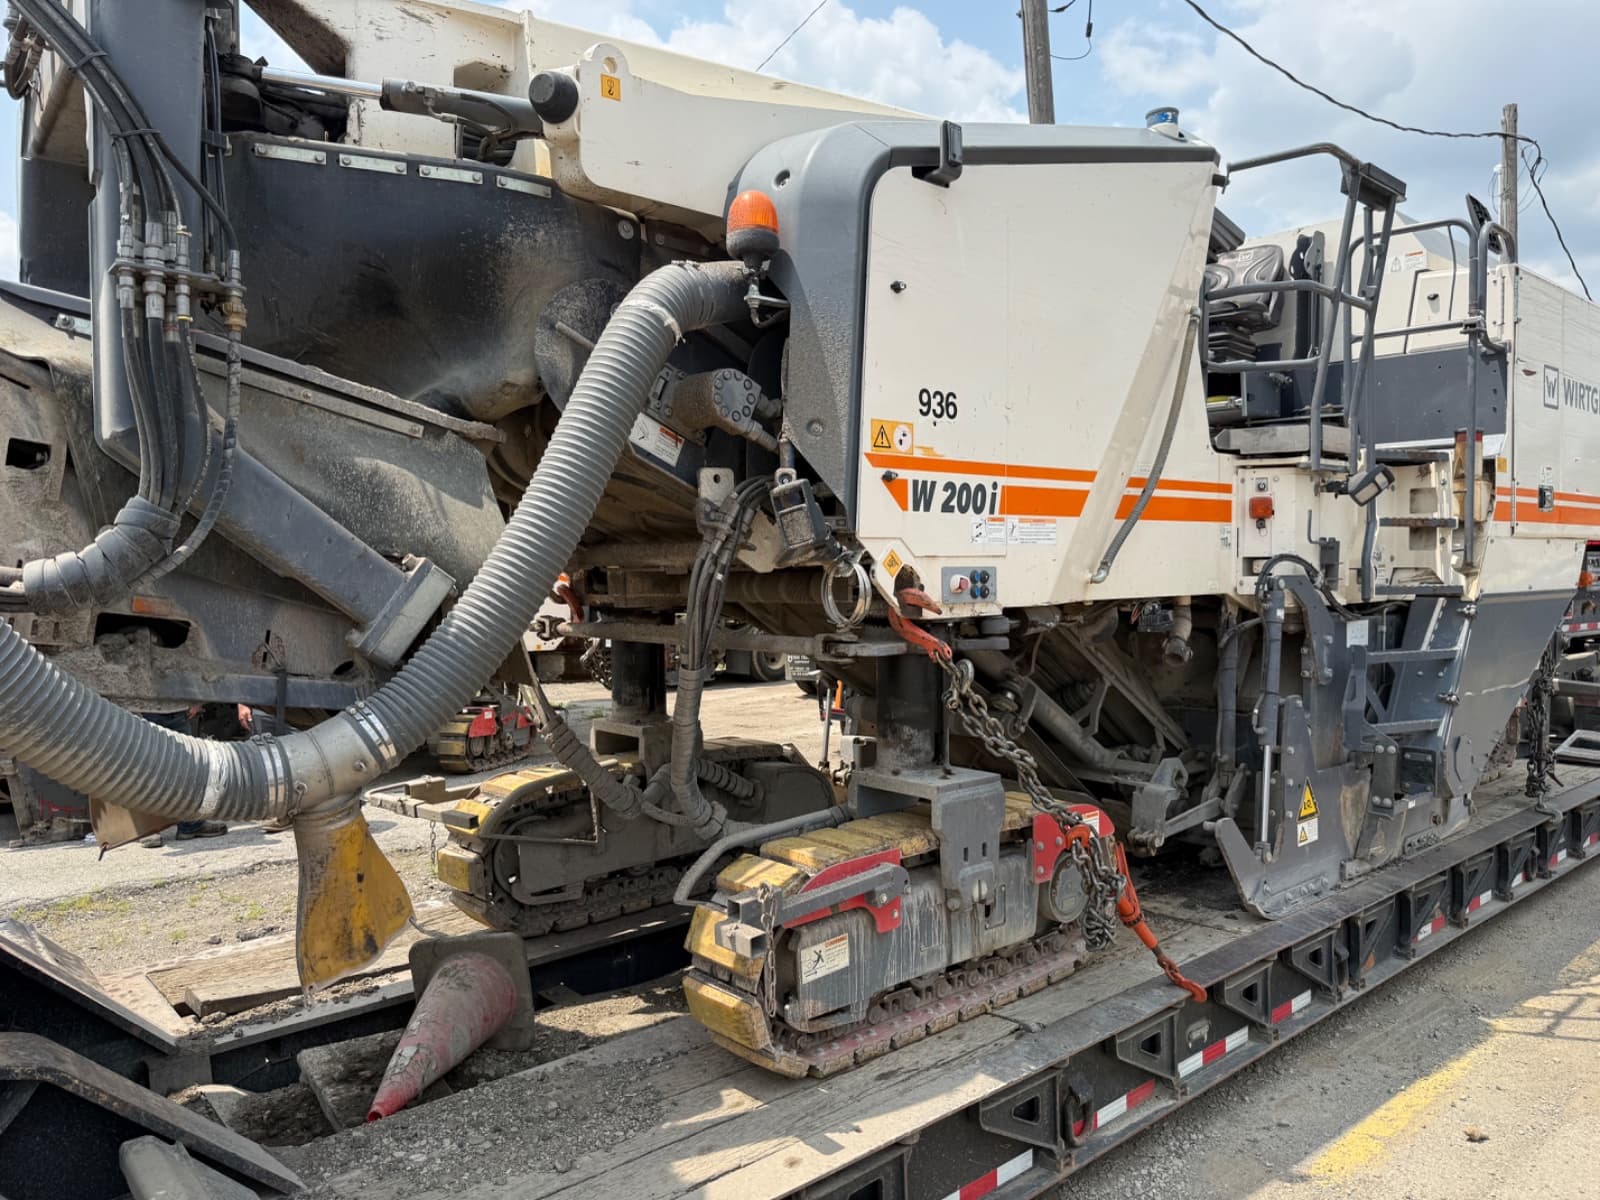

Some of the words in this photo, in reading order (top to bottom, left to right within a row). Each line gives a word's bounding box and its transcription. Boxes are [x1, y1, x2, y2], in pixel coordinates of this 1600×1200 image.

[918, 388, 958, 420] 936
[1562, 376, 1600, 416] WIRTG
[912, 479, 937, 512] W
[941, 481, 998, 516] 200i
